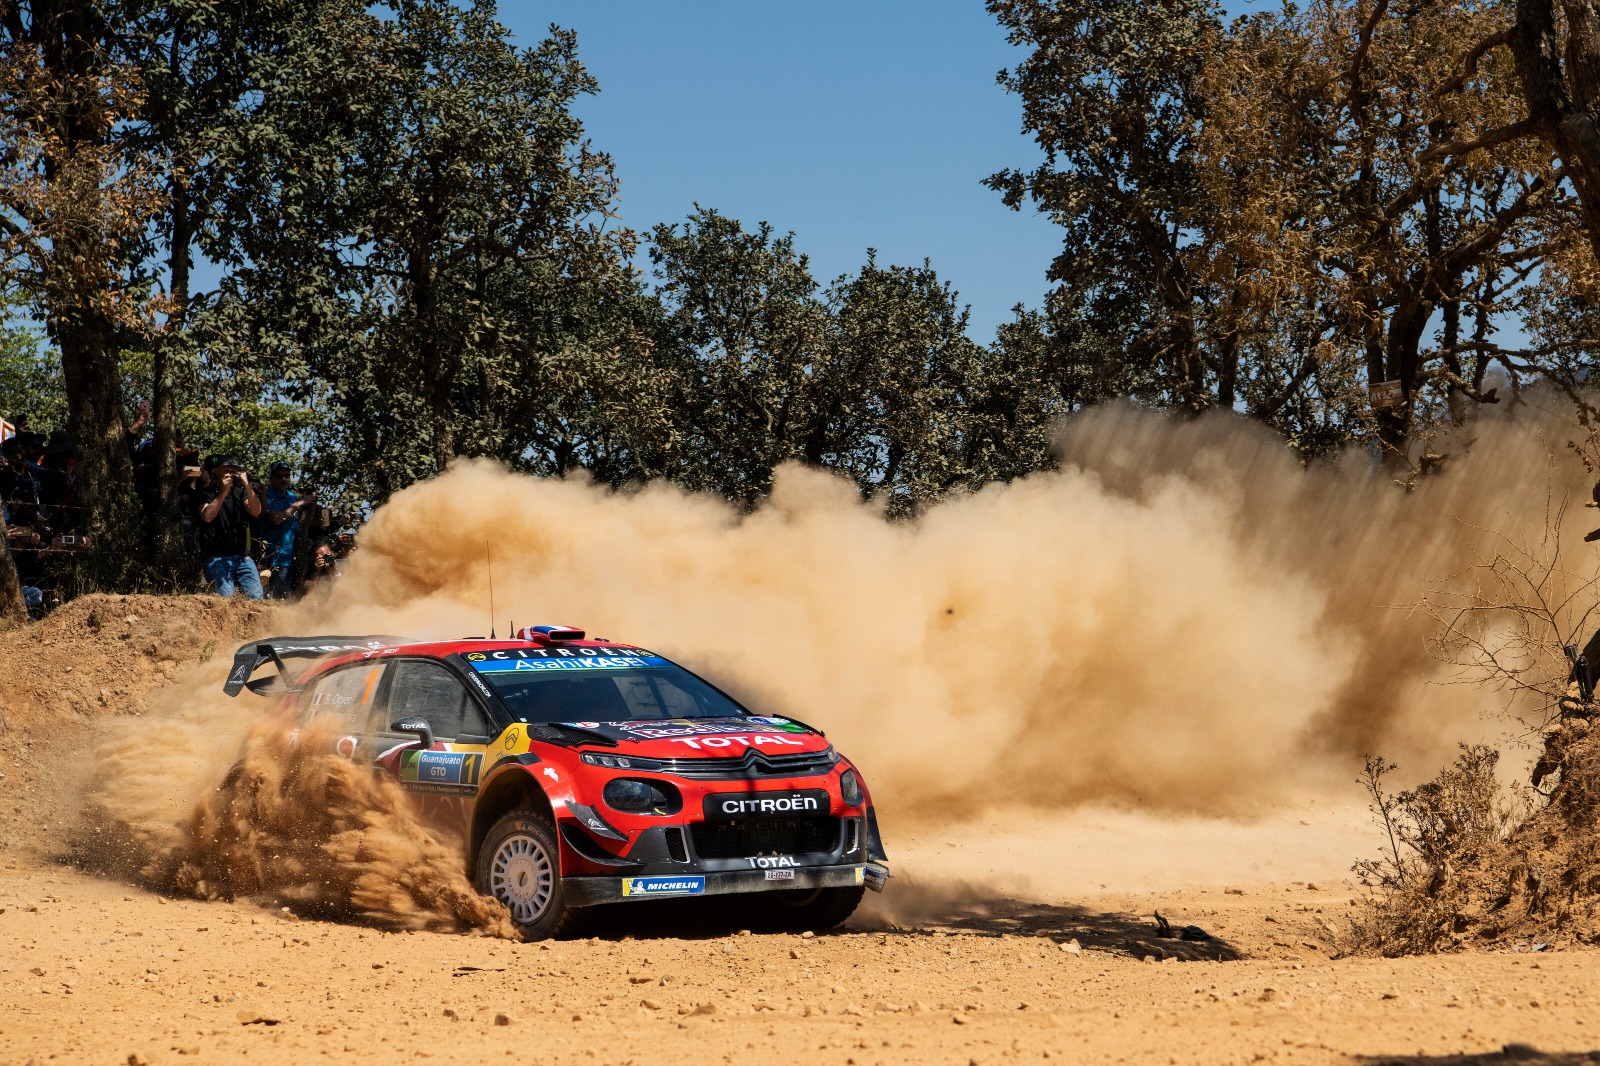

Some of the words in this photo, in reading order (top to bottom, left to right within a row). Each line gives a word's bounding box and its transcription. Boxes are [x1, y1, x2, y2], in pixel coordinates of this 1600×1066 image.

[492, 647, 640, 660] CITROËN
[515, 657, 650, 670] AsahiKASEI
[362, 668, 380, 705] 1
[332, 693, 353, 708] Ogier
[670, 735, 804, 750] TOTAL
[421, 754, 461, 766] Guanajuato
[430, 766, 447, 777] GTO
[465, 754, 477, 784] 1
[722, 793, 818, 814] CITROËN
[745, 856, 801, 869] TOTAL
[647, 881, 699, 890] MICHELIN
